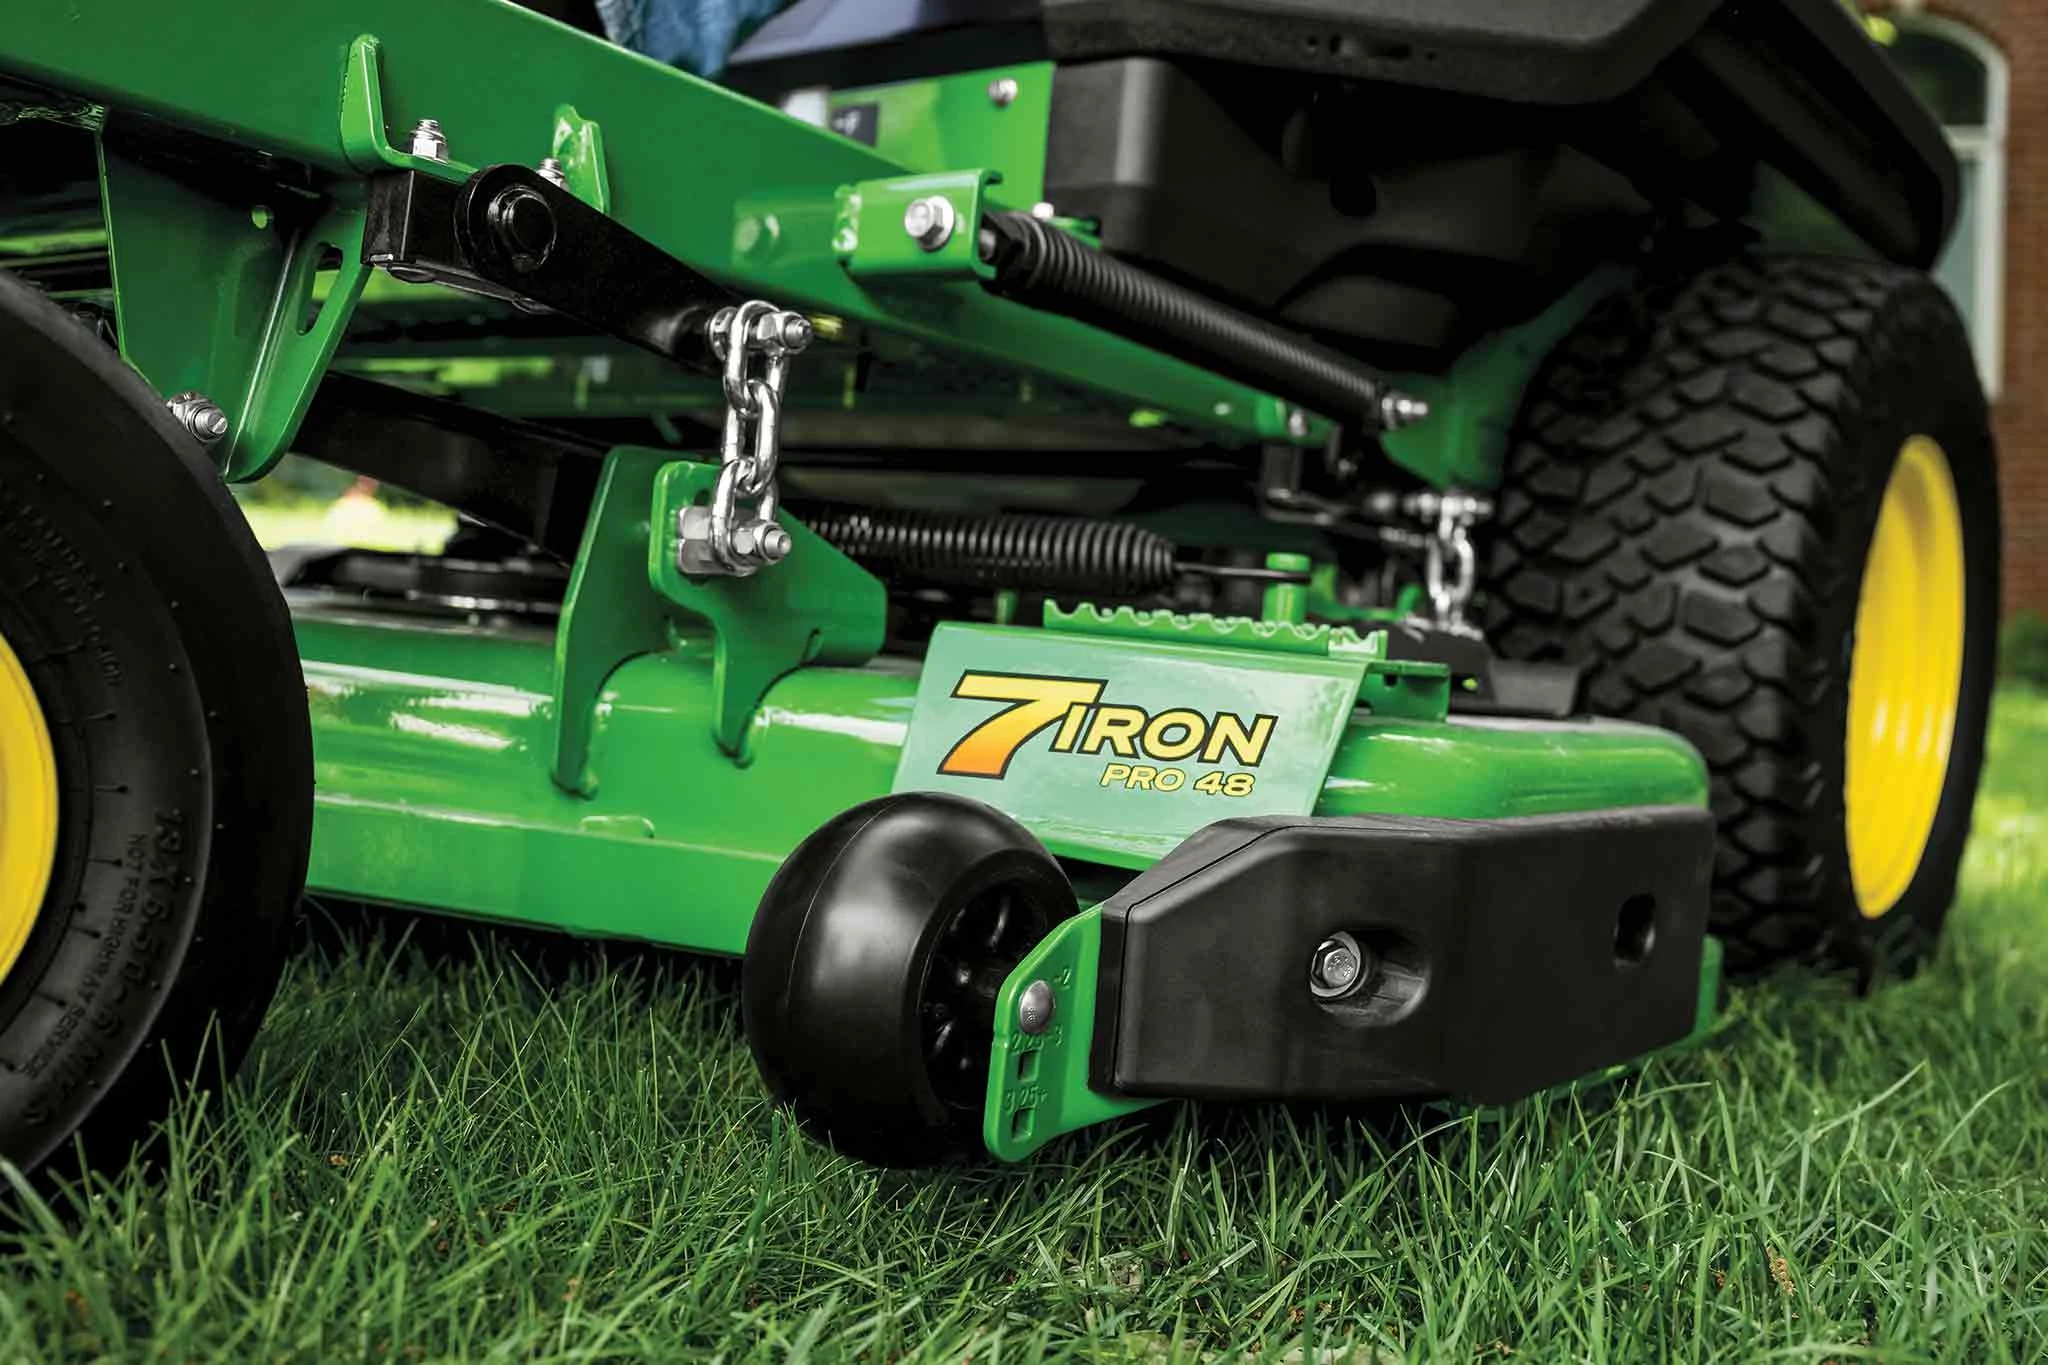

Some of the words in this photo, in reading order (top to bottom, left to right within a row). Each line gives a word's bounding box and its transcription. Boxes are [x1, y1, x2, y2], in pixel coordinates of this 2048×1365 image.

[937, 670, 1108, 779] 7
[1049, 702, 1278, 767] IRON
[1100, 763, 1185, 792] PRO
[1192, 770, 1256, 797] 48
[124, 833, 148, 874] NOT
[111, 876, 138, 915] FOR
[77, 917, 127, 1004] HIGHWAY
[20, 1003, 87, 1080] SERVICE
